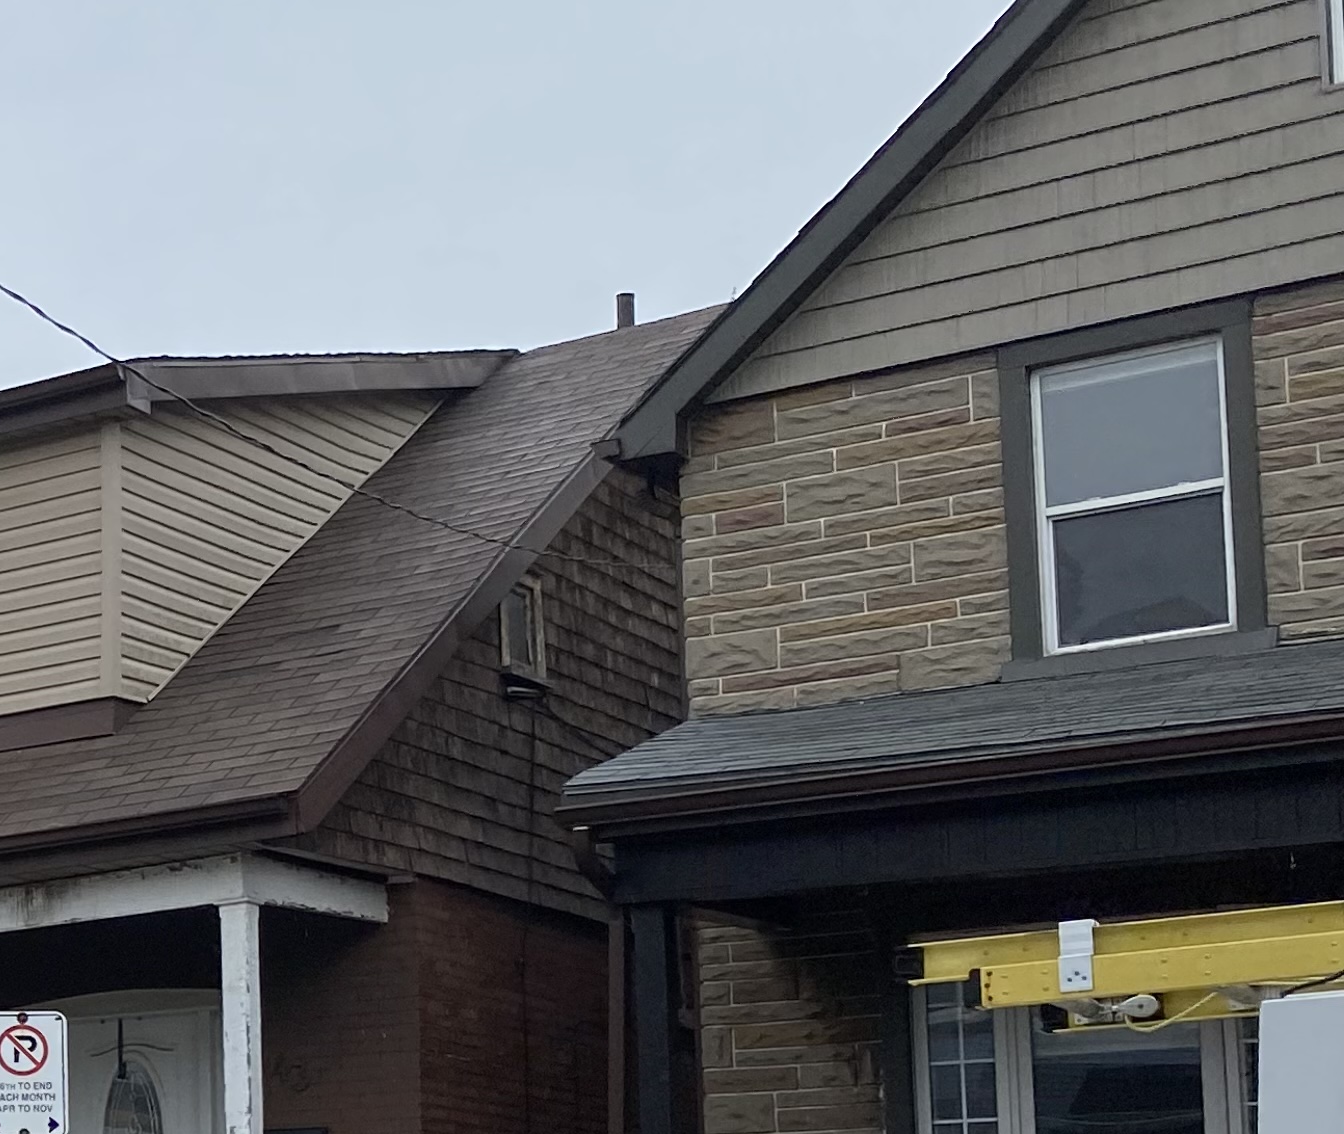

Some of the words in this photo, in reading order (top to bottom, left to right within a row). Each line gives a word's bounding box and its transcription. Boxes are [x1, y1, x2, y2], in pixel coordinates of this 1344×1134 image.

[18, 1082, 31, 1090] TO
[33, 1082, 53, 1090] END
[21, 1093, 56, 1102] MONTH
[18, 1104, 31, 1113] TO
[33, 1104, 53, 1113] NOV
